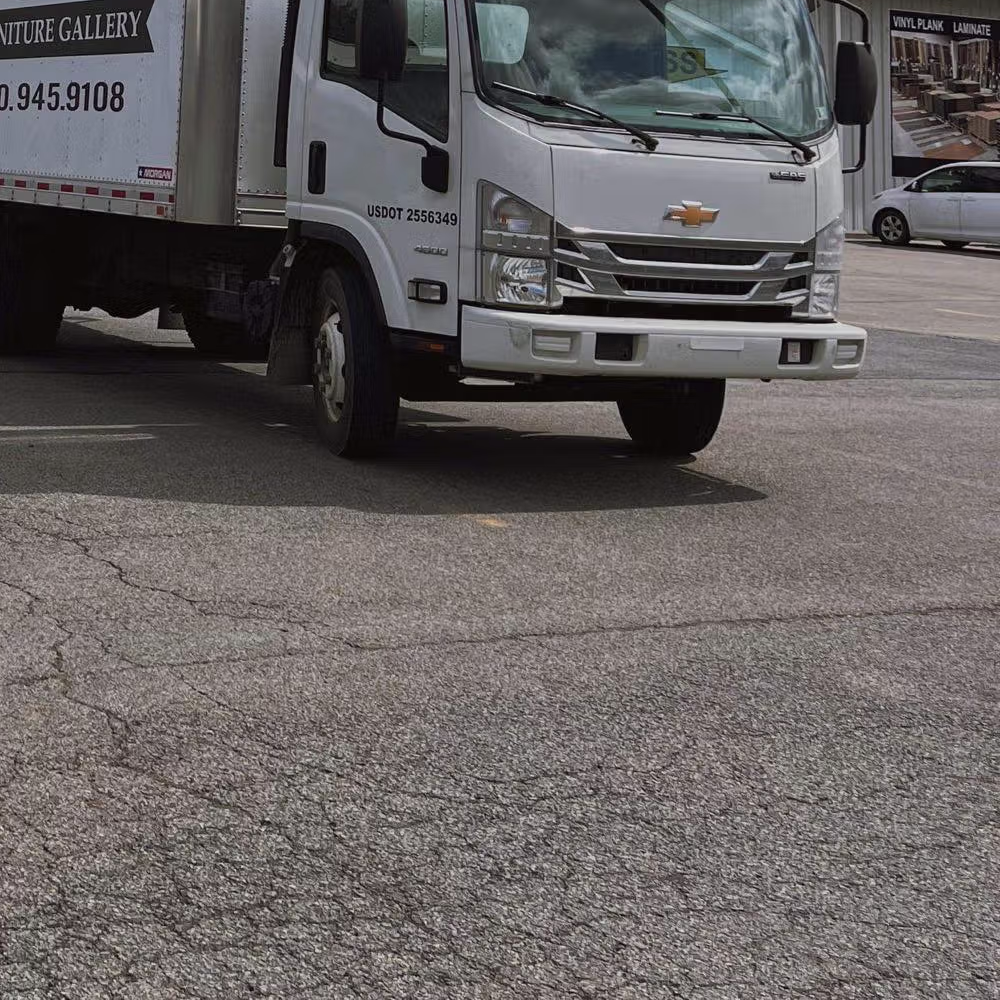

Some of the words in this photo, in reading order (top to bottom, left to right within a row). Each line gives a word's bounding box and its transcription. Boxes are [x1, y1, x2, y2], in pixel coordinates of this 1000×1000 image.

[59, 10, 142, 42] GALLERY
[893, 15, 916, 29] VINYL
[917, 18, 944, 32] PLANK
[953, 21, 991, 36] LAMINATE
[142, 168, 172, 180] MORGAN
[367, 204, 403, 220] USDOT
[407, 208, 458, 226] 2556349
